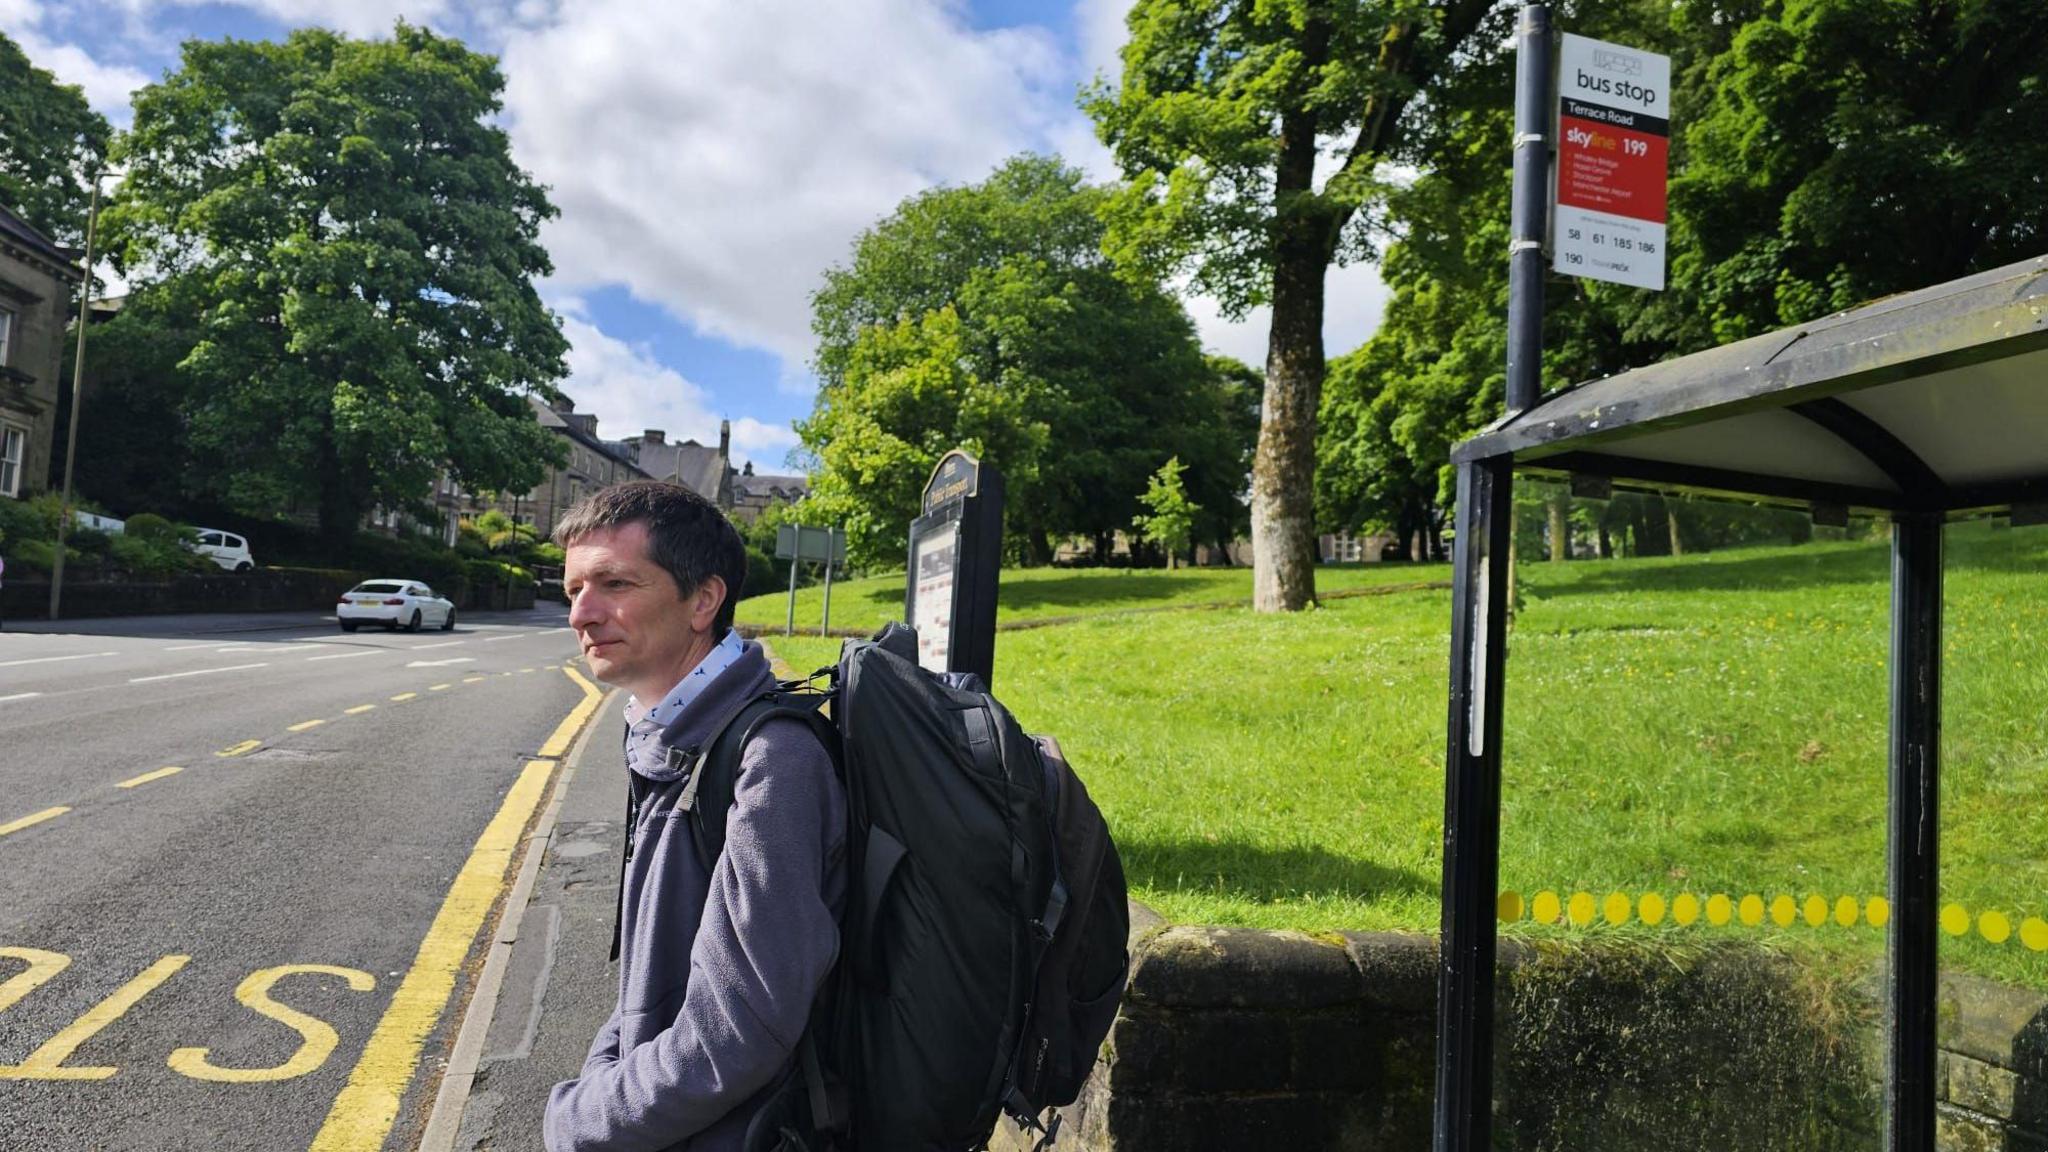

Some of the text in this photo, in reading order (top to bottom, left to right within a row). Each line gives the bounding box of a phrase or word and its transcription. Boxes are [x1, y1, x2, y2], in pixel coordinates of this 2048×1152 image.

[1577, 68, 1655, 107] bus stop
[1568, 102, 1634, 126] Terrace Road
[1567, 127, 1648, 157] skyline 199
[1568, 229, 1656, 254] 58 61 185 186
[1565, 252, 1583, 265] 190
